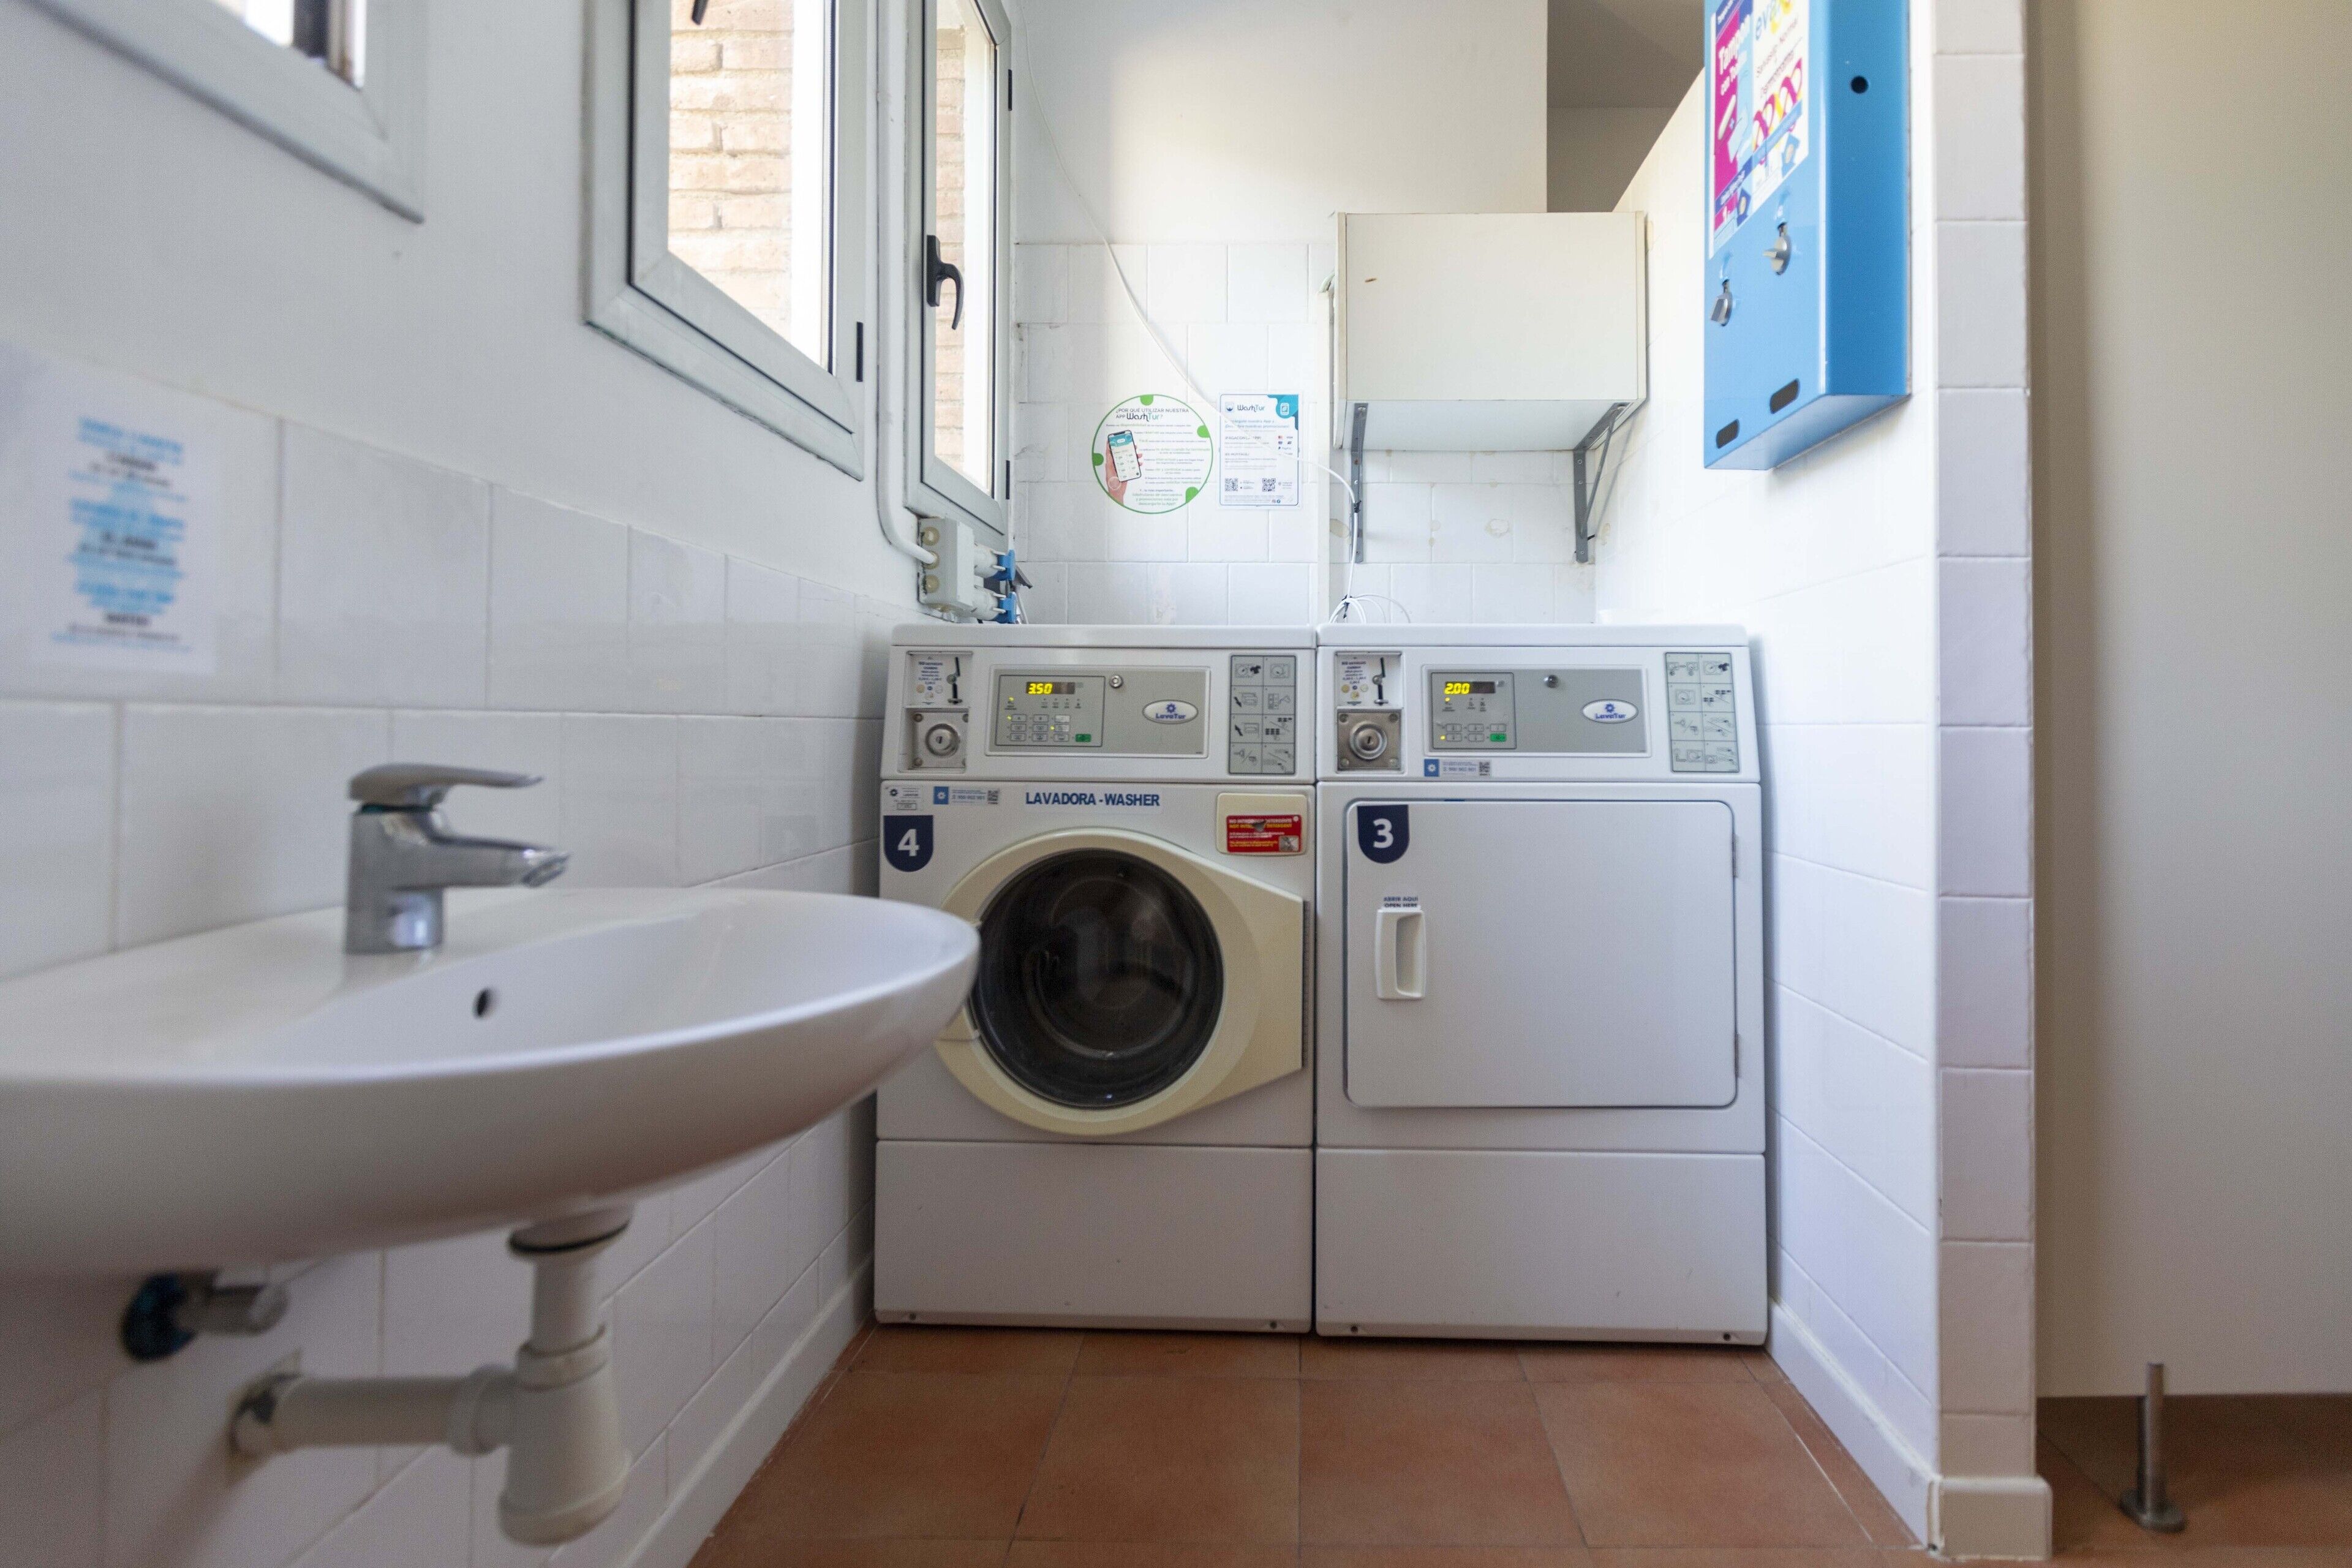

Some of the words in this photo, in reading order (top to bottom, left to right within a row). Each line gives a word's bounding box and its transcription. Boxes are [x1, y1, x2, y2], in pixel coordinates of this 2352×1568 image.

[1025, 792, 1096, 805] LAVADORA
[897, 828, 919, 857] 4
[1373, 818, 1394, 849] 3
